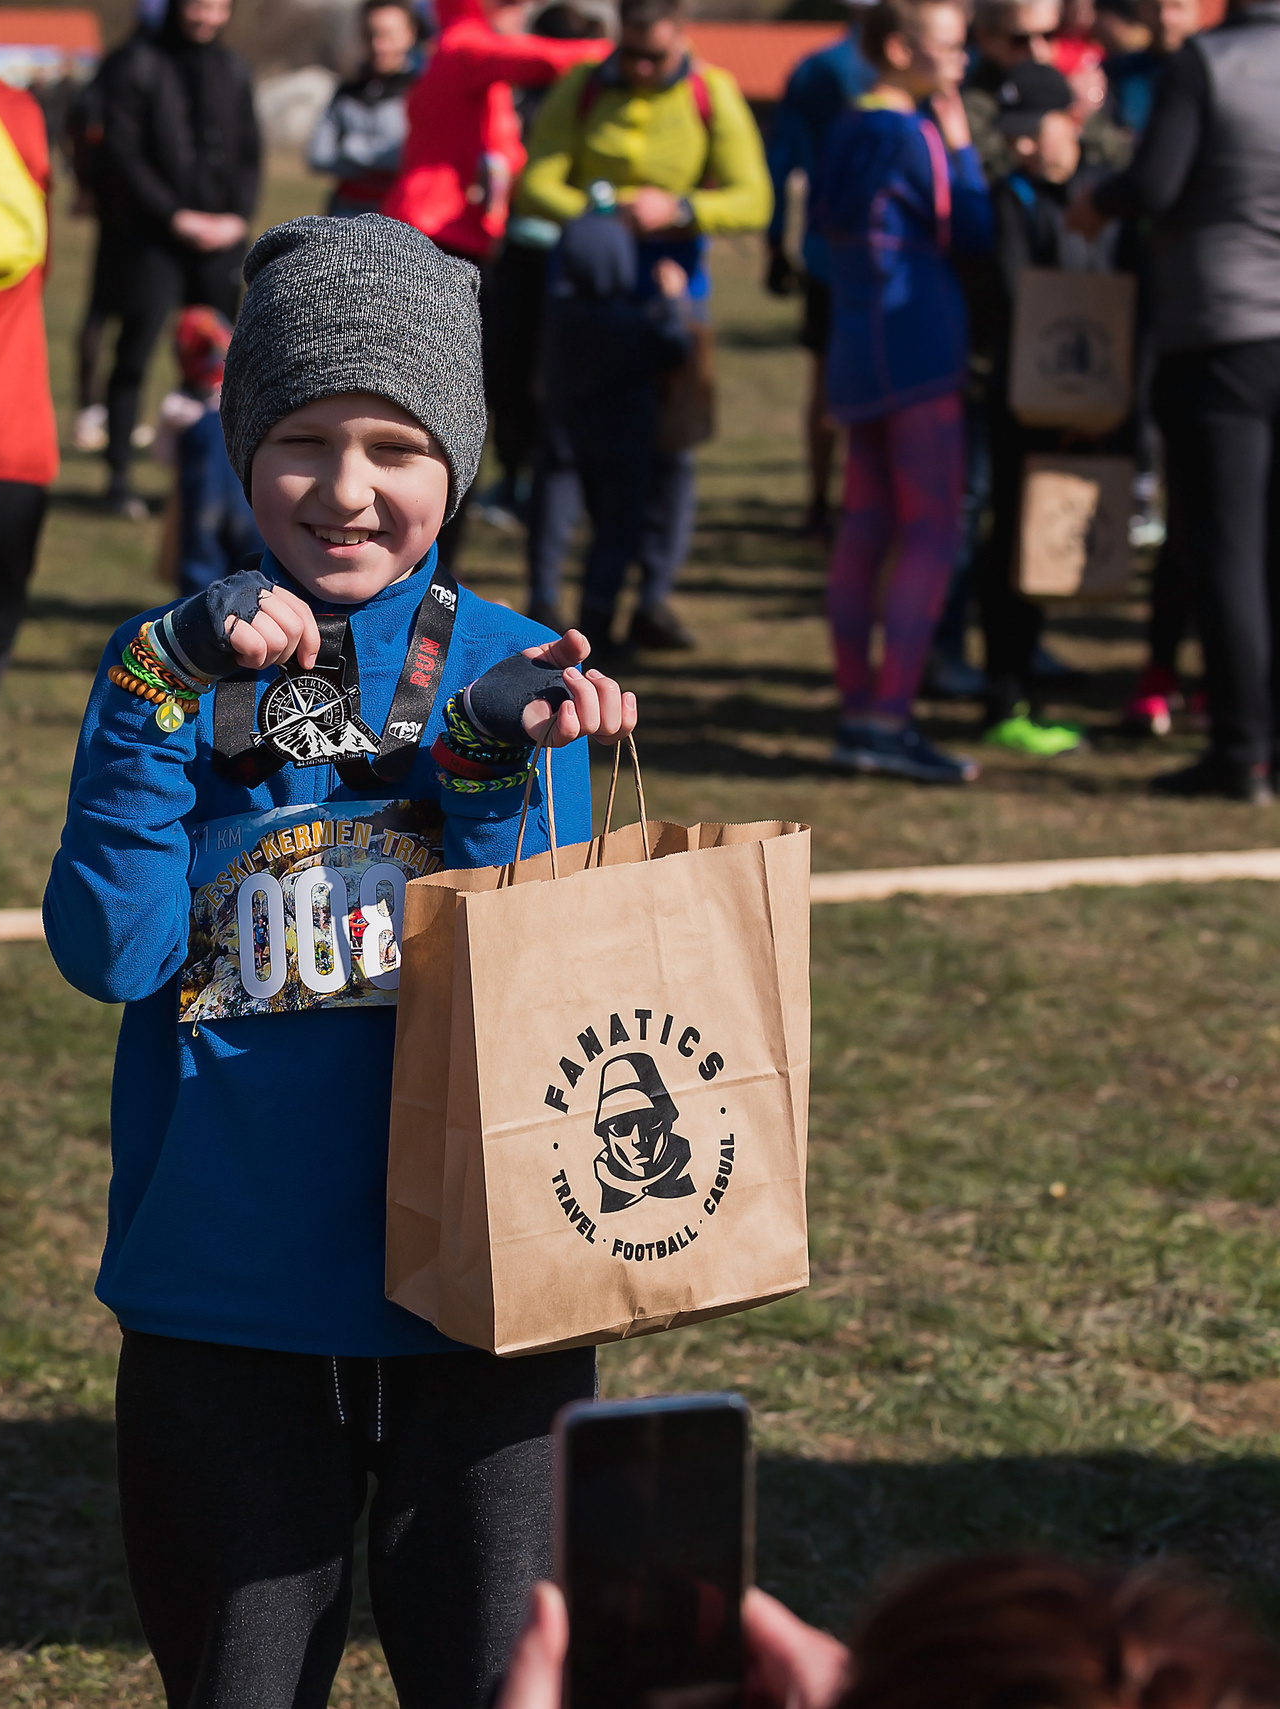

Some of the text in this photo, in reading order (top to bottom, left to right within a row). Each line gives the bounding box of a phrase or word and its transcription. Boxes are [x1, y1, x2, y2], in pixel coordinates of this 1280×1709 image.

[297, 679, 335, 698] KERMEN
[410, 636, 441, 688] RUN
[202, 825, 242, 853] 1 KM
[205, 821, 445, 910] ESKI-KERMEN TRAI
[237, 862, 407, 998] 008
[543, 1008, 725, 1115] FANATICS
[551, 1133, 735, 1262] TRAVEL FOOTBALL CASUAL
